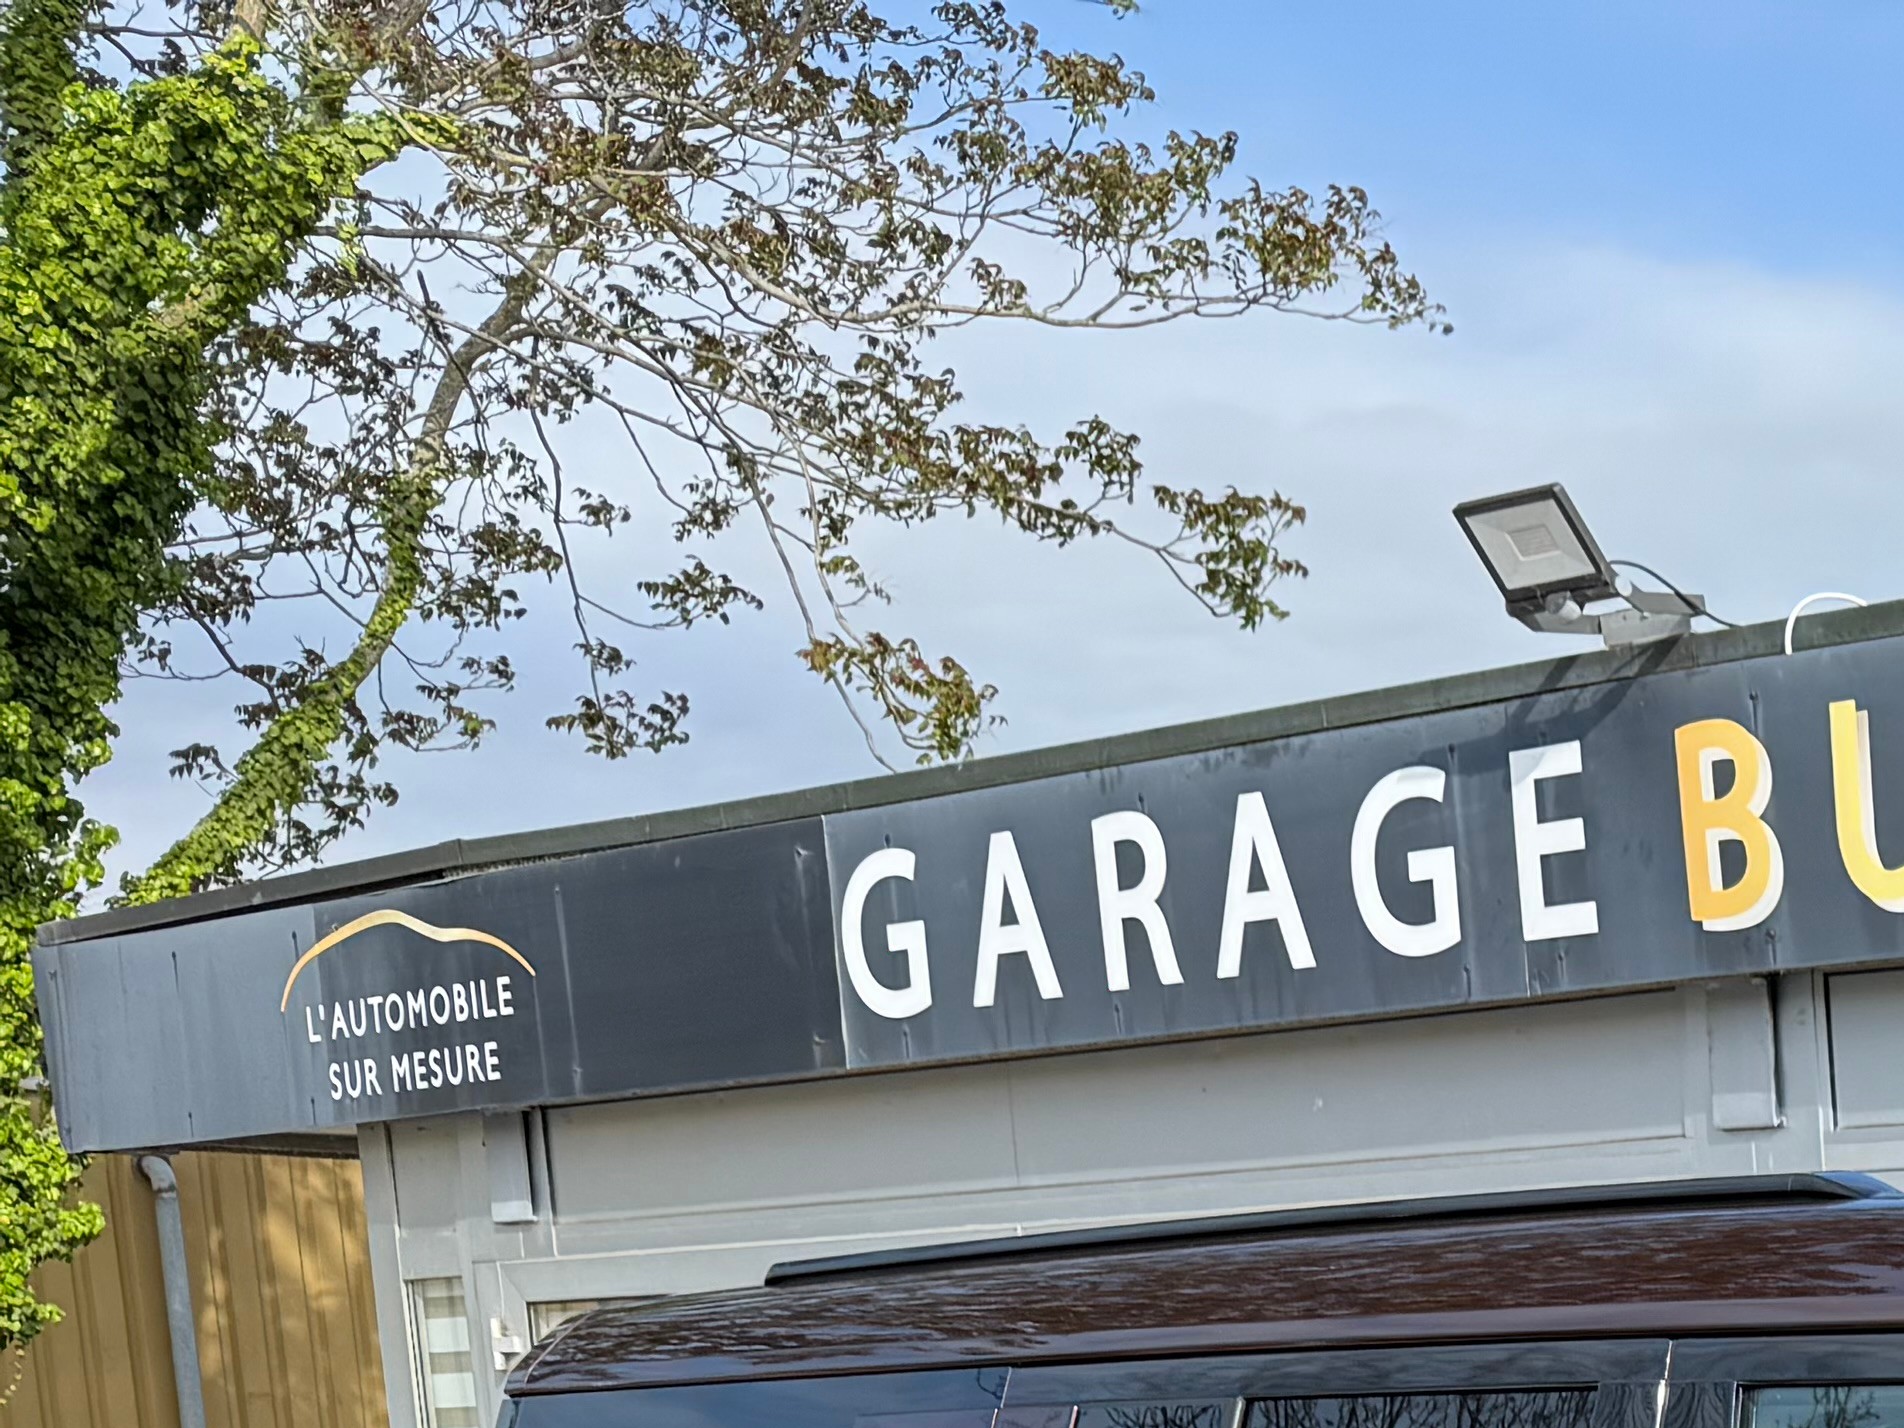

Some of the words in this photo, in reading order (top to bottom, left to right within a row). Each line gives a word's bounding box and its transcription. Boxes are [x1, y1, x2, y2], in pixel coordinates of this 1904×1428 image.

[840, 742, 1600, 1020] GARAGE
[306, 974, 515, 1044] L'AUTOMOBILE
[328, 1055, 383, 1102] SUR
[390, 1041, 502, 1093] MESURE
